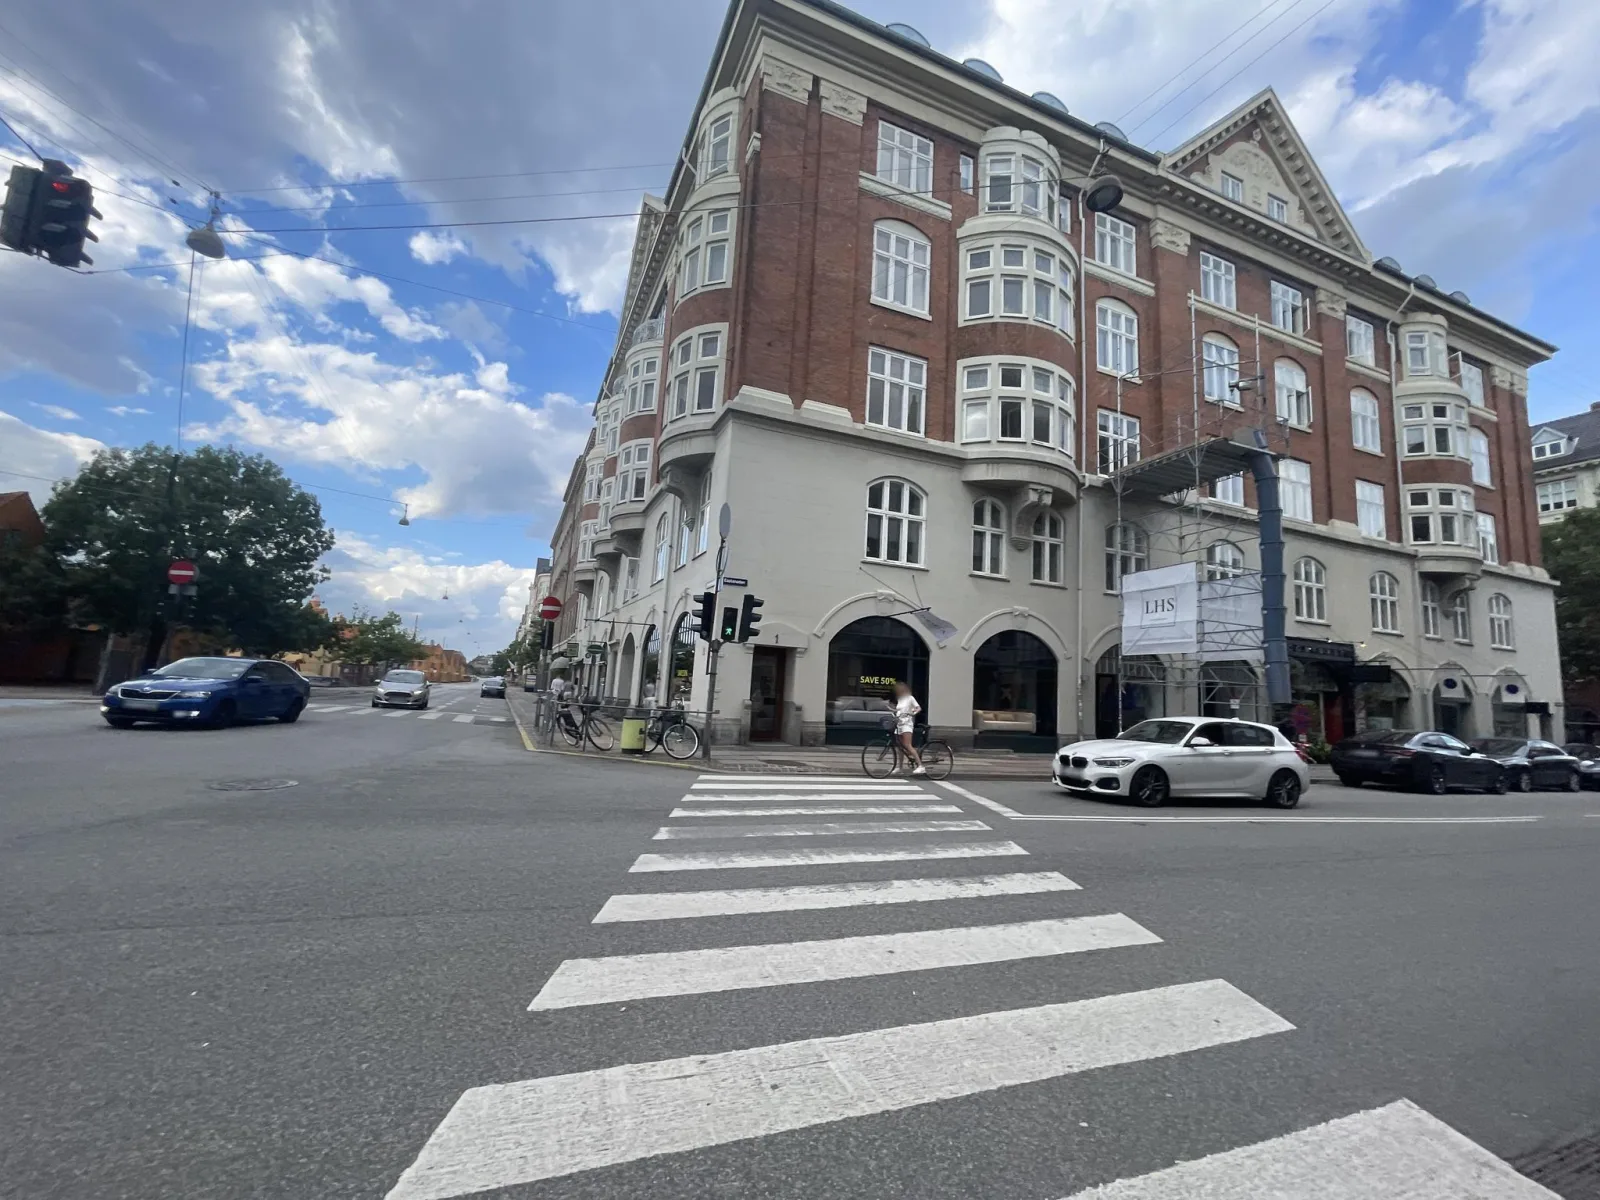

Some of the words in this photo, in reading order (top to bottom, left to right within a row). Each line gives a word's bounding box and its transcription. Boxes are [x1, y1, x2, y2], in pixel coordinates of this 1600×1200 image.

[1145, 597, 1175, 614] LHS
[860, 675, 880, 684] SAVE
[880, 677, 897, 685] 50%
